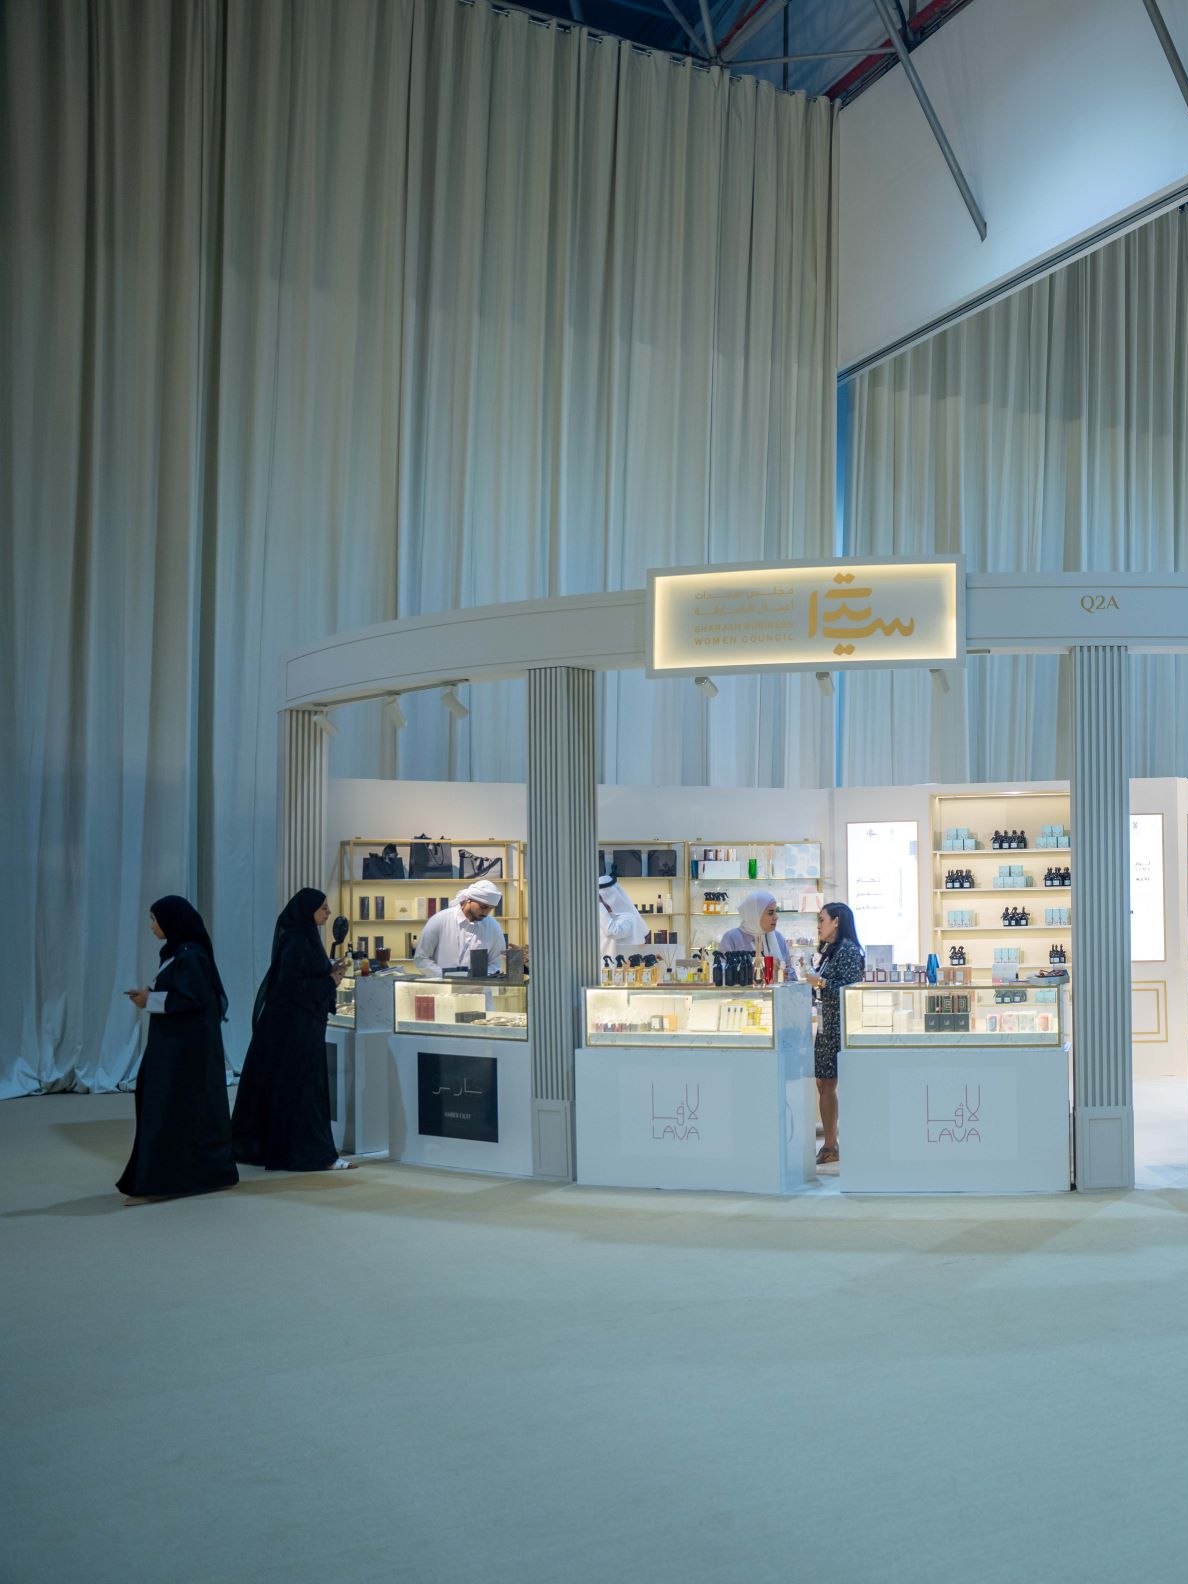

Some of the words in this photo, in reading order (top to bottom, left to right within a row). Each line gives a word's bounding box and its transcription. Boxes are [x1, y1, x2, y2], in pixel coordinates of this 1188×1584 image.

[1080, 595, 1120, 613] Q2A
[694, 636, 737, 645] WOMEN
[742, 633, 794, 643] COUNCIL
[652, 1125, 700, 1141] LAVA
[927, 1127, 981, 1143] LAVA
